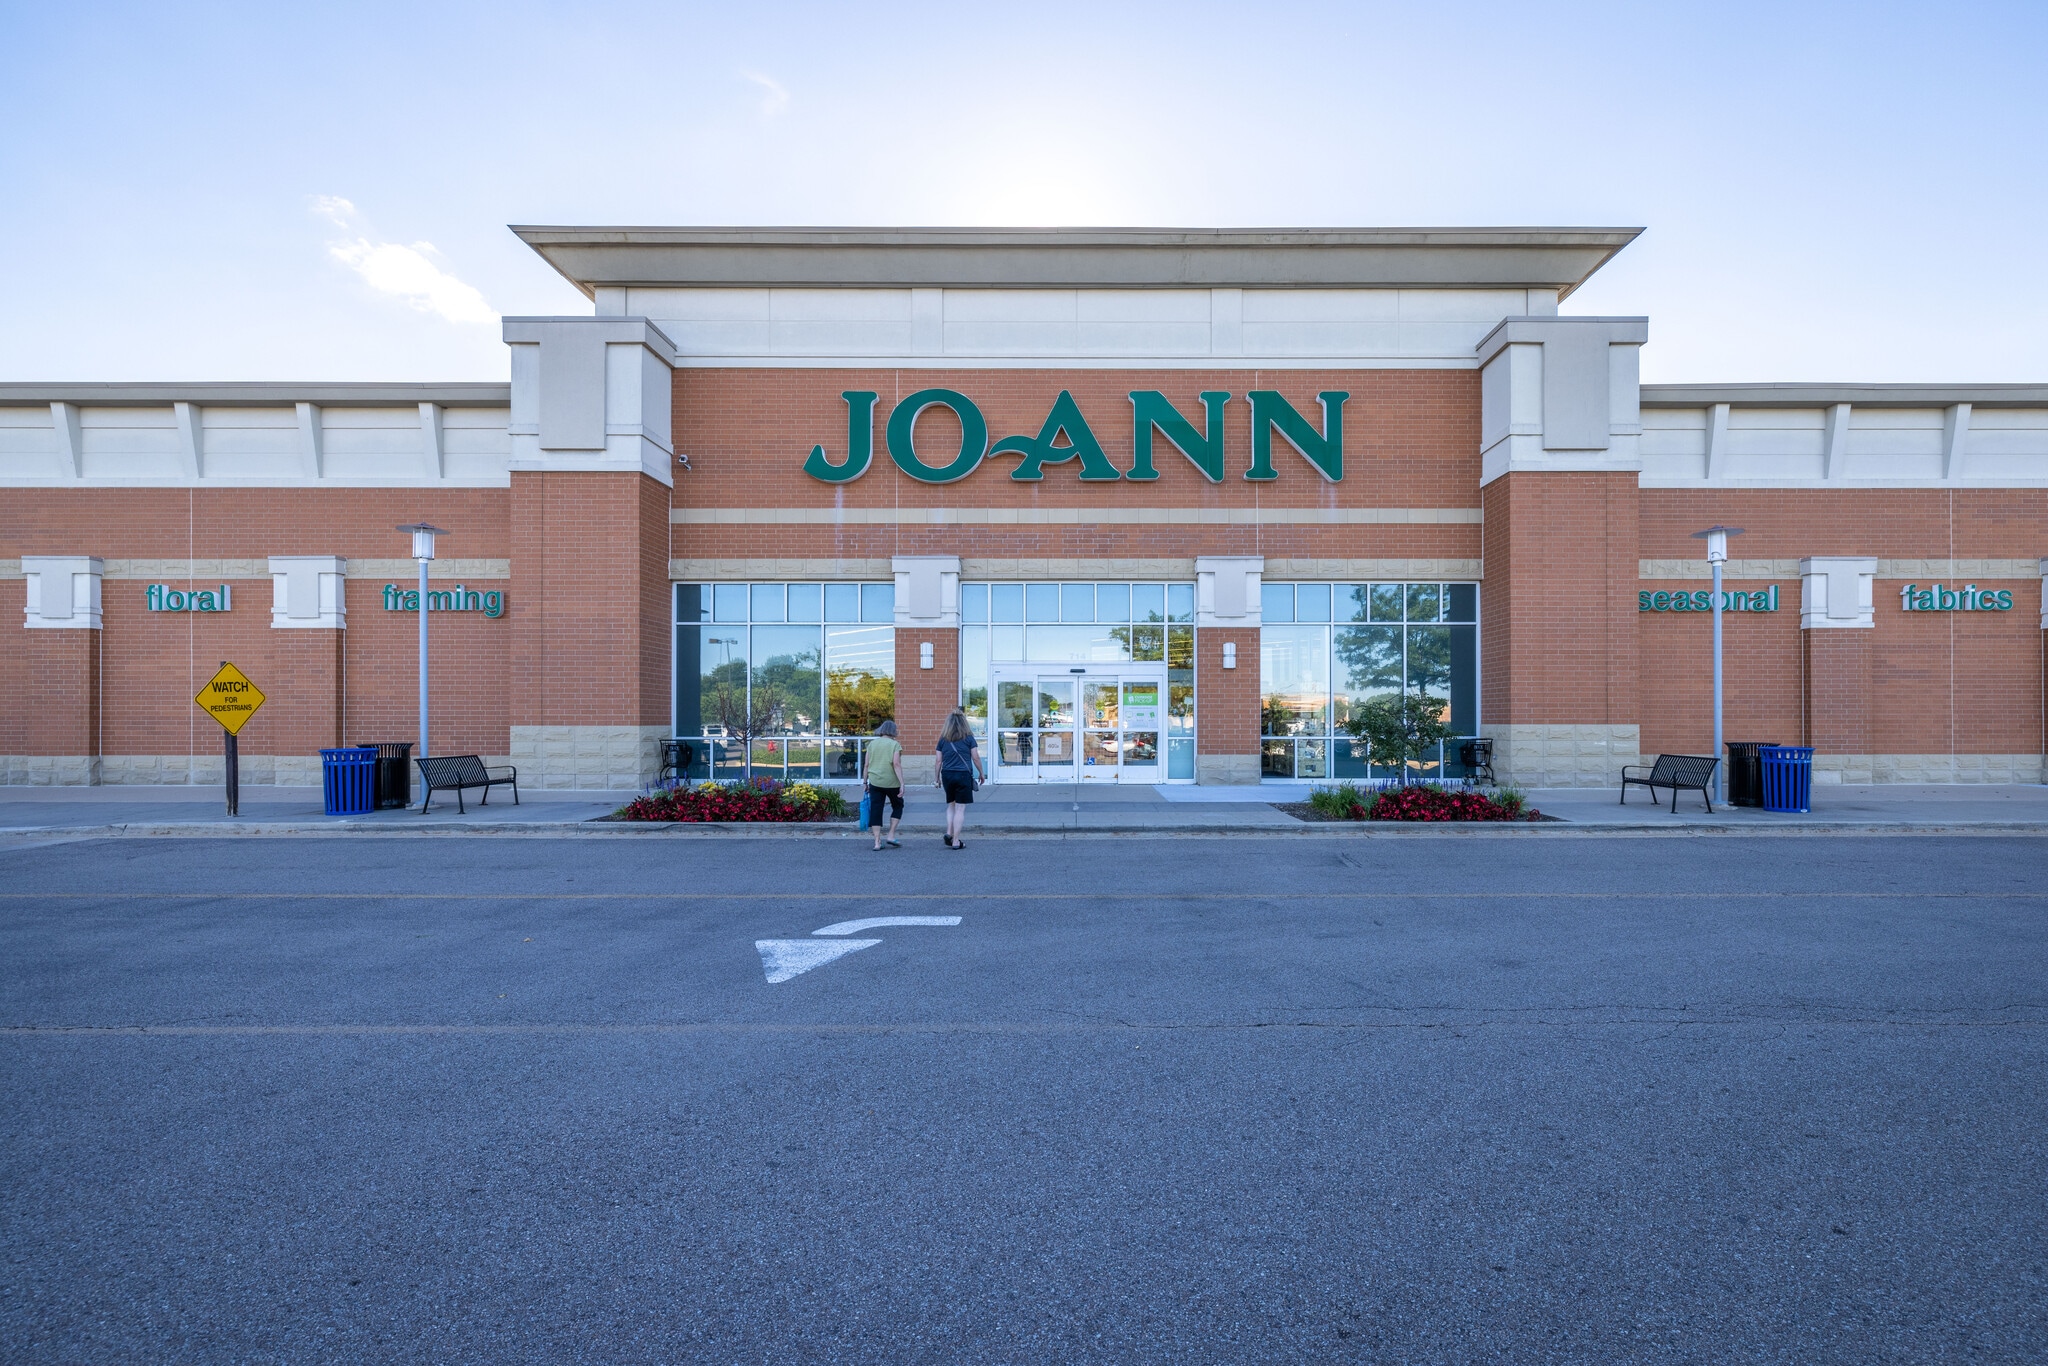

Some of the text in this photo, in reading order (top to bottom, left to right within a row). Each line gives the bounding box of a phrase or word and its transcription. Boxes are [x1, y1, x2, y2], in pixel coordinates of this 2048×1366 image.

[145, 584, 231, 612] floral
[382, 584, 504, 618] framing
[1902, 584, 2014, 611] fabrics
[211, 681, 249, 693] WATCH
[210, 704, 252, 712] PEDESTRIANS
